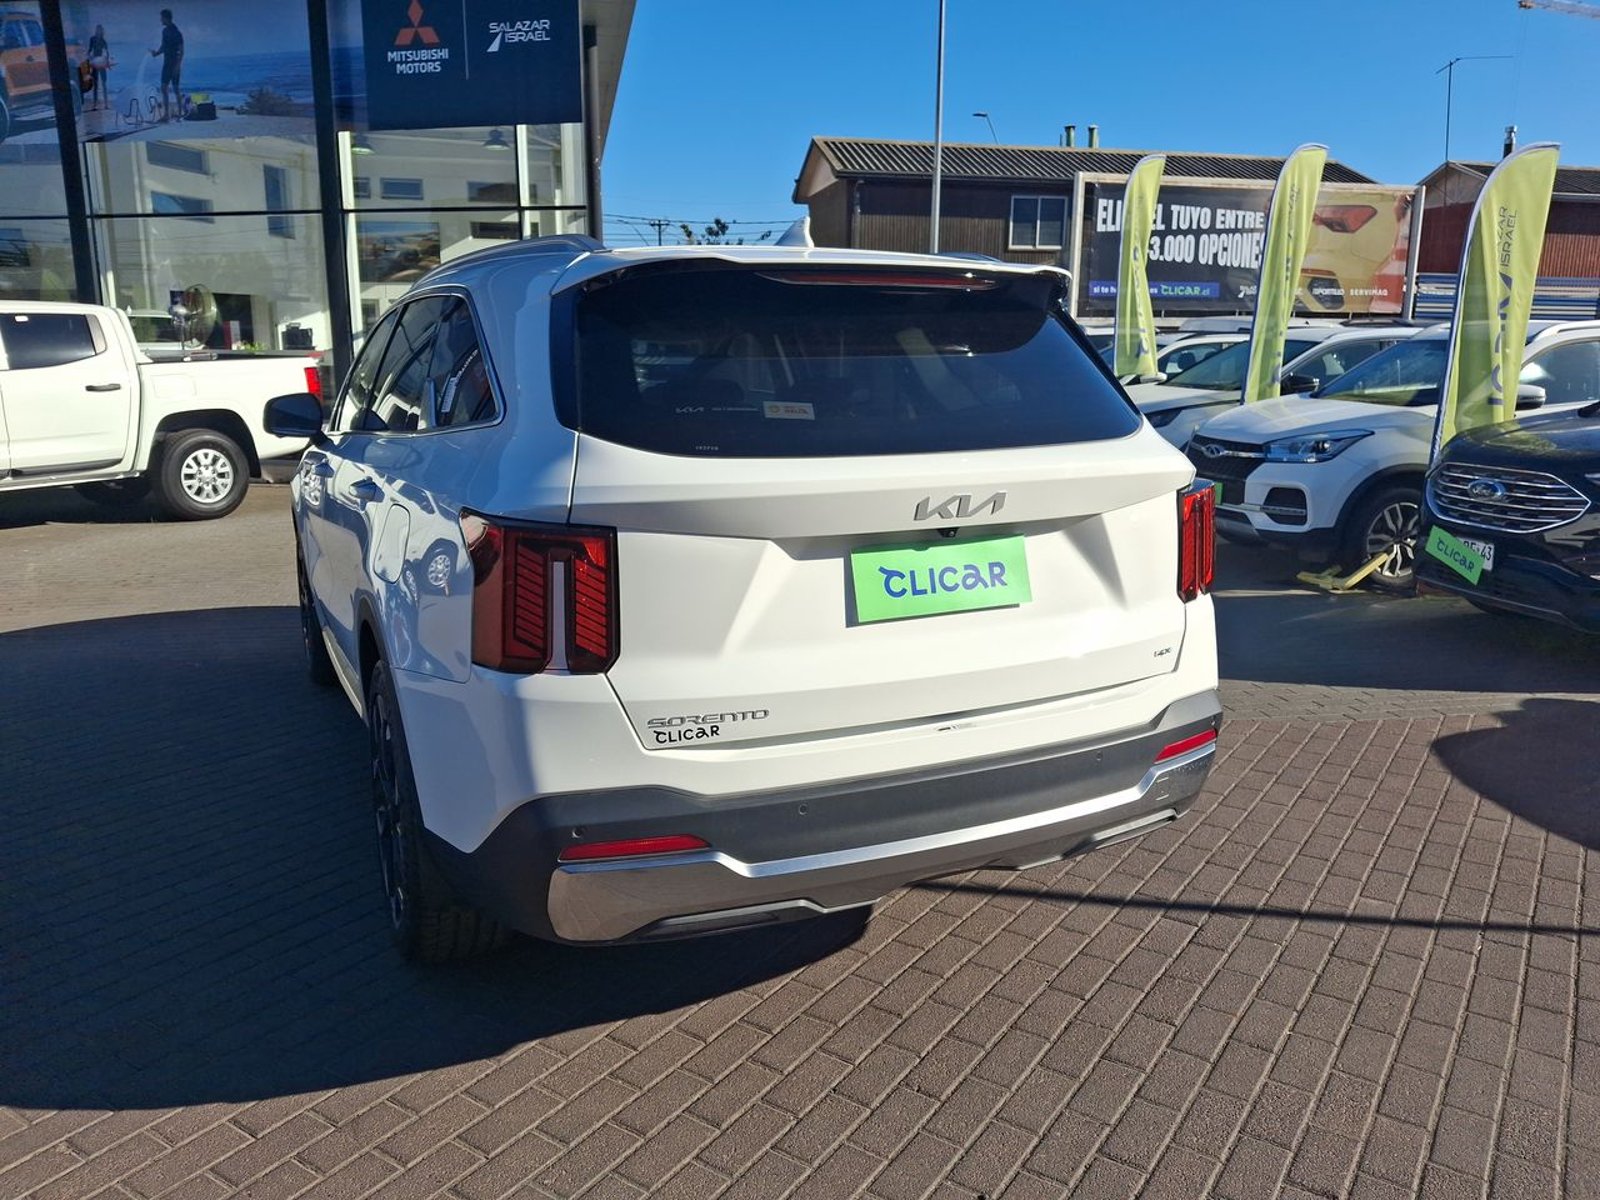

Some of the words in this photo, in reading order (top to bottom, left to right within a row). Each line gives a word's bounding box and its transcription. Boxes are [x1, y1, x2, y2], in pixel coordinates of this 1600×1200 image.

[489, 19, 550, 34] SALAZAR
[505, 31, 550, 43] ISRAEL
[387, 48, 449, 63] MITSUBISHI
[396, 61, 442, 75] MOTORS
[1096, 198, 1122, 232] ELI
[1171, 204, 1212, 231] TUYO
[1215, 208, 1265, 230] ENTRE
[1147, 234, 1196, 263] 3.000
[1500, 210, 1518, 267] ISRAEL
[913, 492, 1007, 521] KIA
[647, 709, 769, 729] SORENTO
